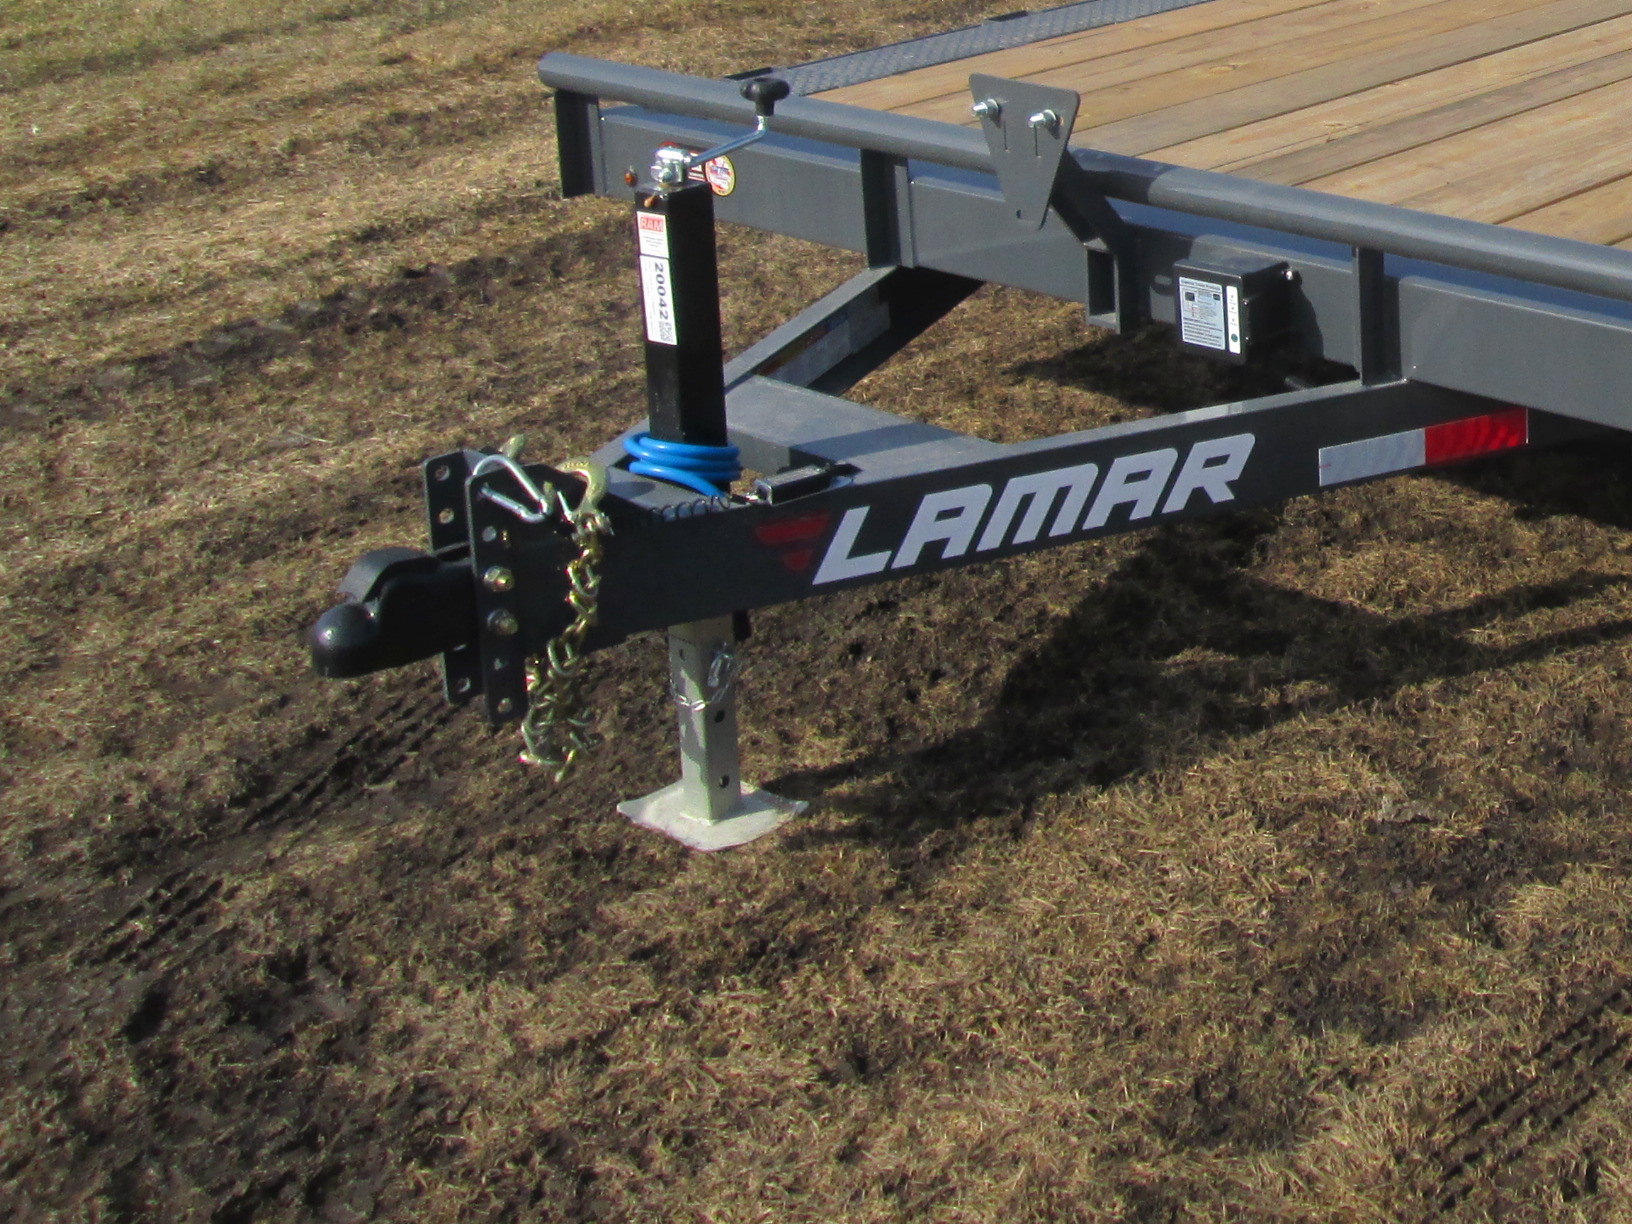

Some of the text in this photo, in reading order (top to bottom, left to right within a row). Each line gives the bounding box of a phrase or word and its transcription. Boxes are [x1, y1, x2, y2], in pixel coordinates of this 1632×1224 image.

[640, 216, 664, 232] RAM
[654, 262, 669, 320] 20042
[811, 432, 1256, 586] LAMAR
